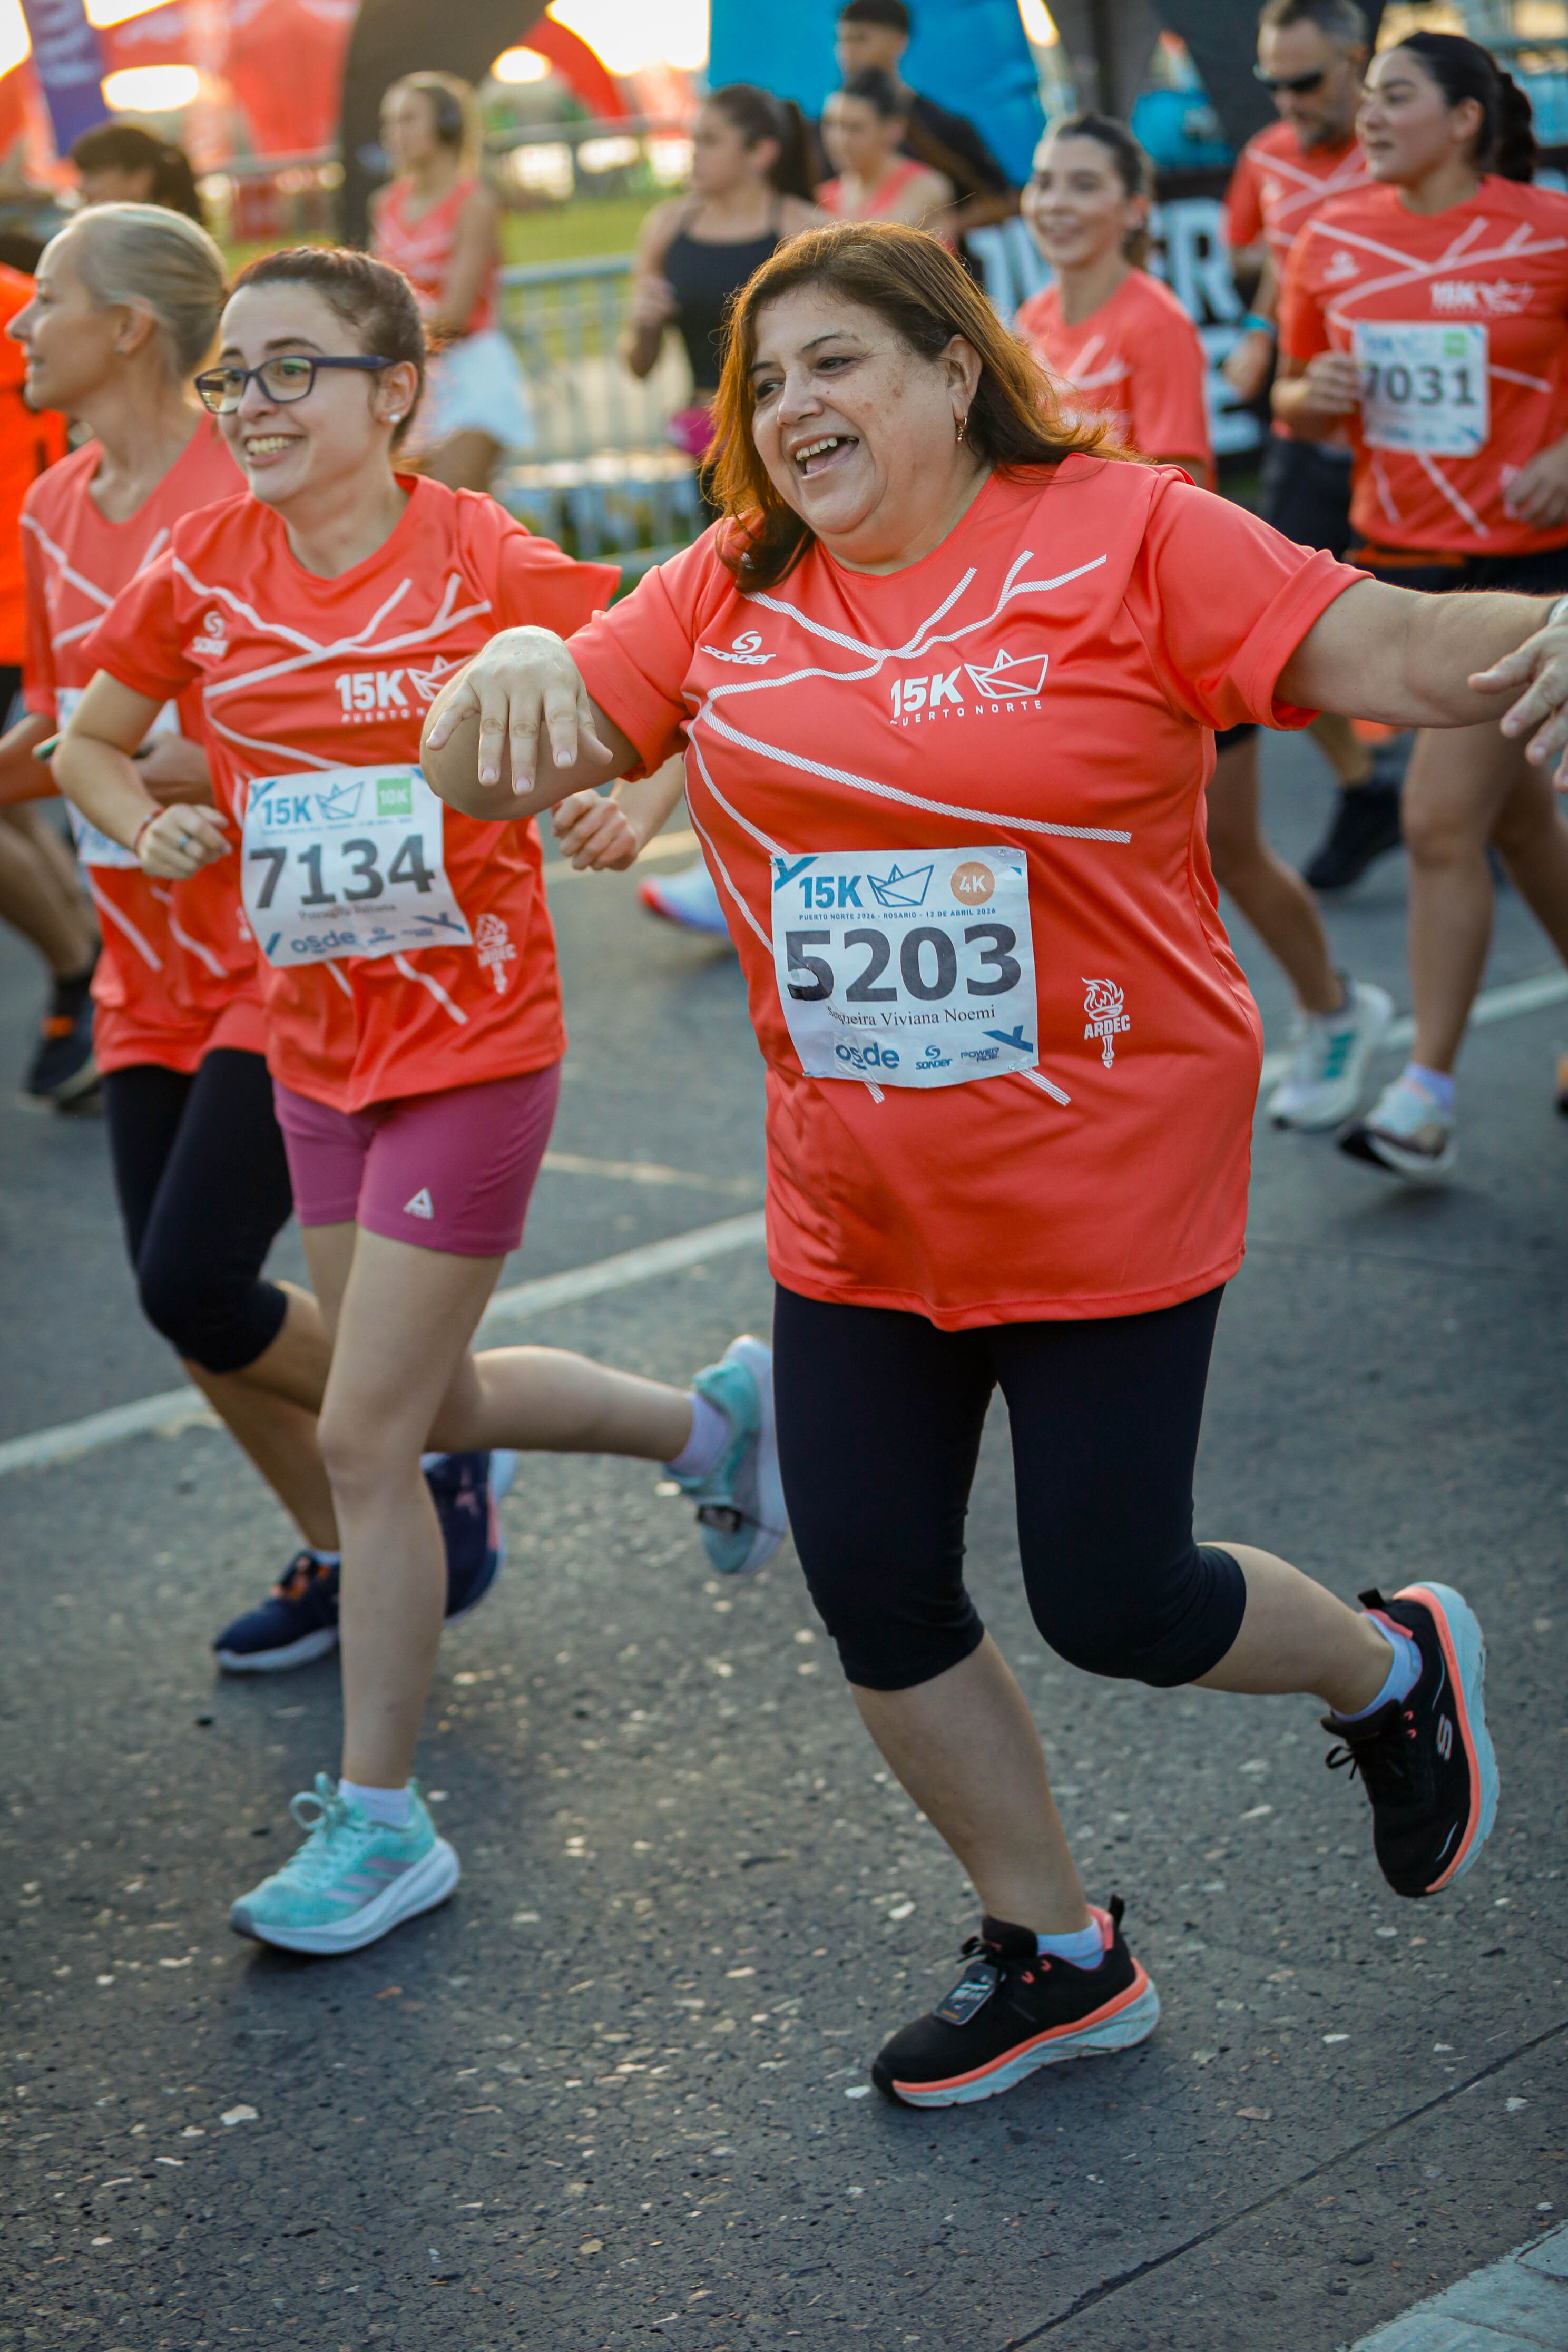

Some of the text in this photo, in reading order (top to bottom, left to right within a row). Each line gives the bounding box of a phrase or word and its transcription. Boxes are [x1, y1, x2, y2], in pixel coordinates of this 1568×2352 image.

[335, 669, 408, 711] 15K
[890, 666, 964, 718] 15K
[976, 700, 1042, 714] NORTE
[262, 795, 311, 825] 15K
[379, 789, 409, 805] 10K
[249, 834, 436, 909] 7134
[959, 875, 987, 894] 4K
[799, 875, 864, 908] 15K
[291, 930, 356, 953] osde
[785, 923, 1022, 1002] 5203
[880, 1011, 939, 1026] Viviana
[944, 1005, 995, 1023] Noemi
[1084, 1015, 1131, 1040] ARDEC
[836, 1042, 900, 1070] osde
